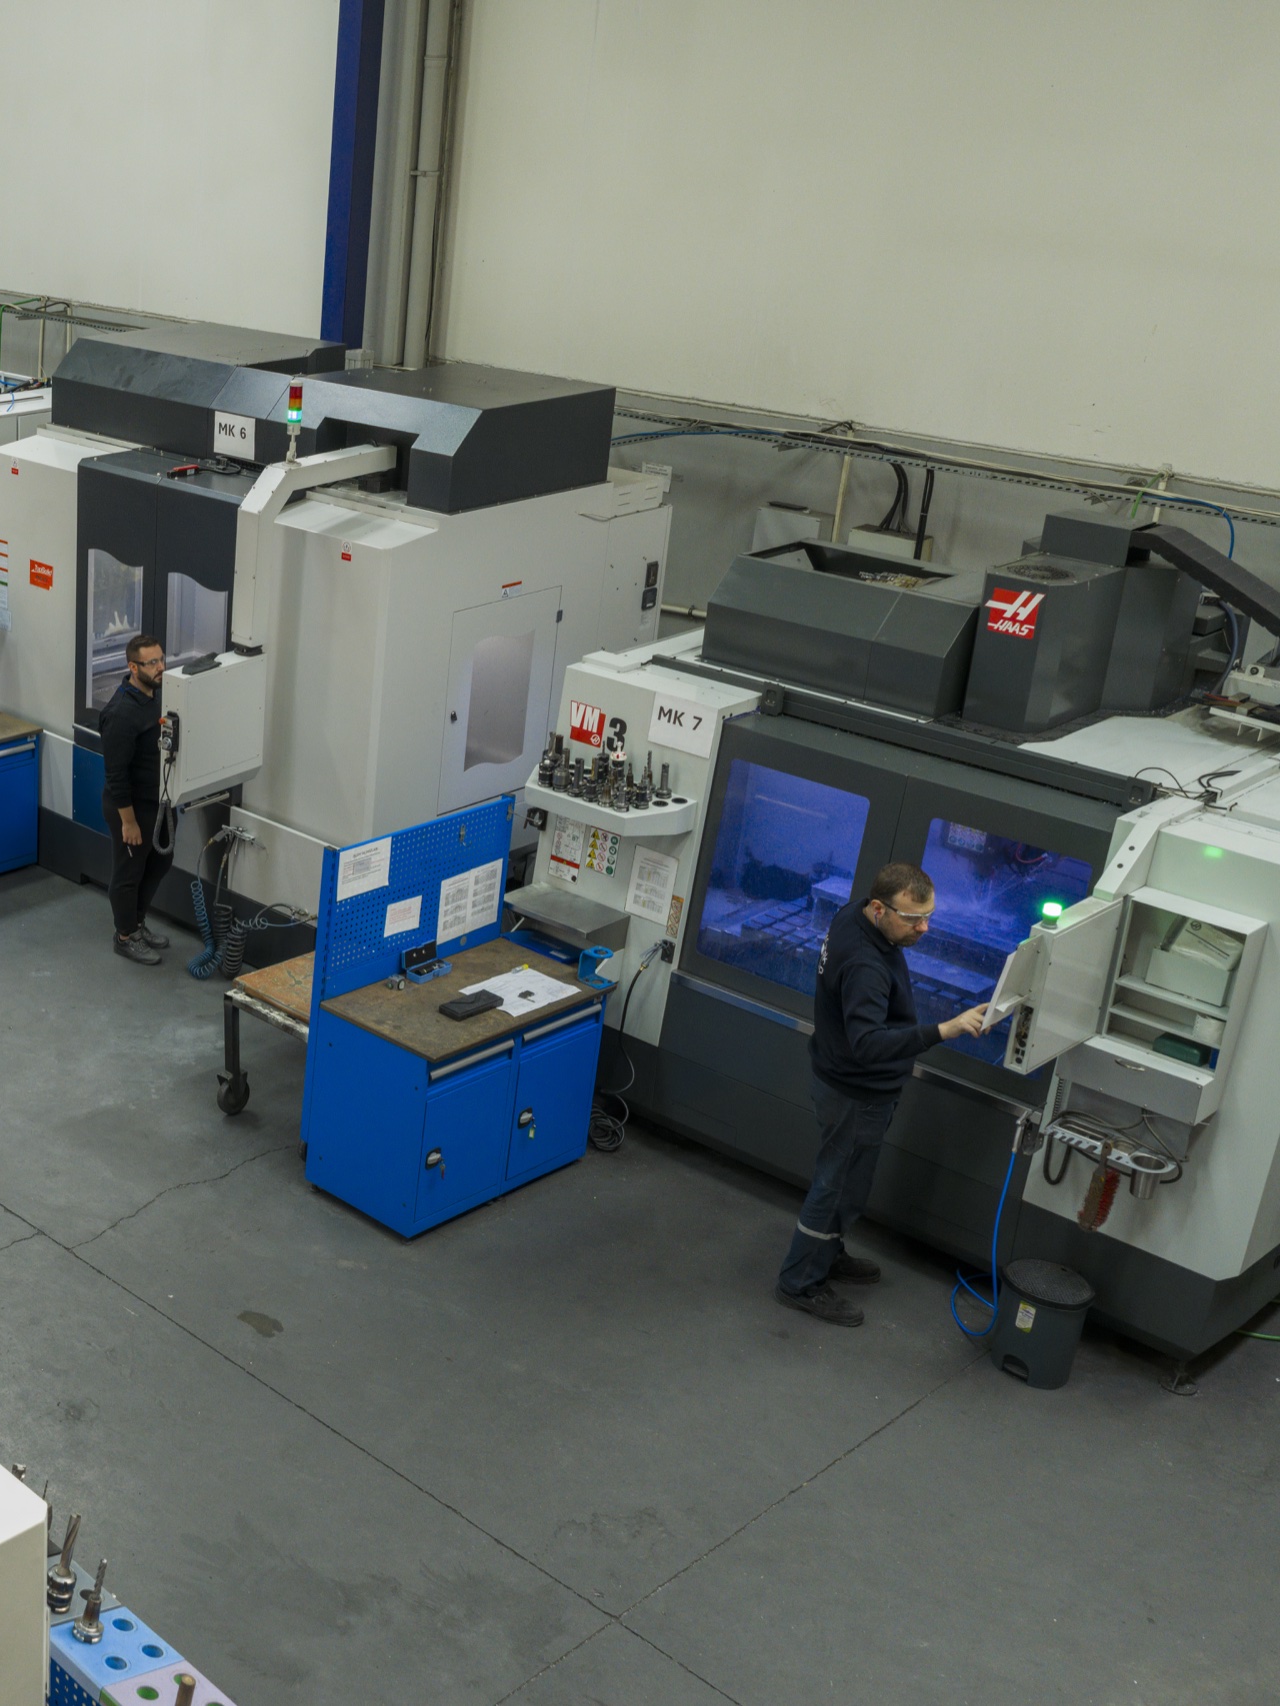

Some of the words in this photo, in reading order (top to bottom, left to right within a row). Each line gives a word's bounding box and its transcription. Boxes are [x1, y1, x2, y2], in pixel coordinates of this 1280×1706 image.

[218, 422, 235, 438] MK
[240, 427, 247, 440] 6
[987, 619, 1035, 636] HAAS
[571, 701, 601, 733] VM
[606, 717, 627, 753] 3
[657, 705, 685, 727] MK
[692, 715, 703, 731] 7
